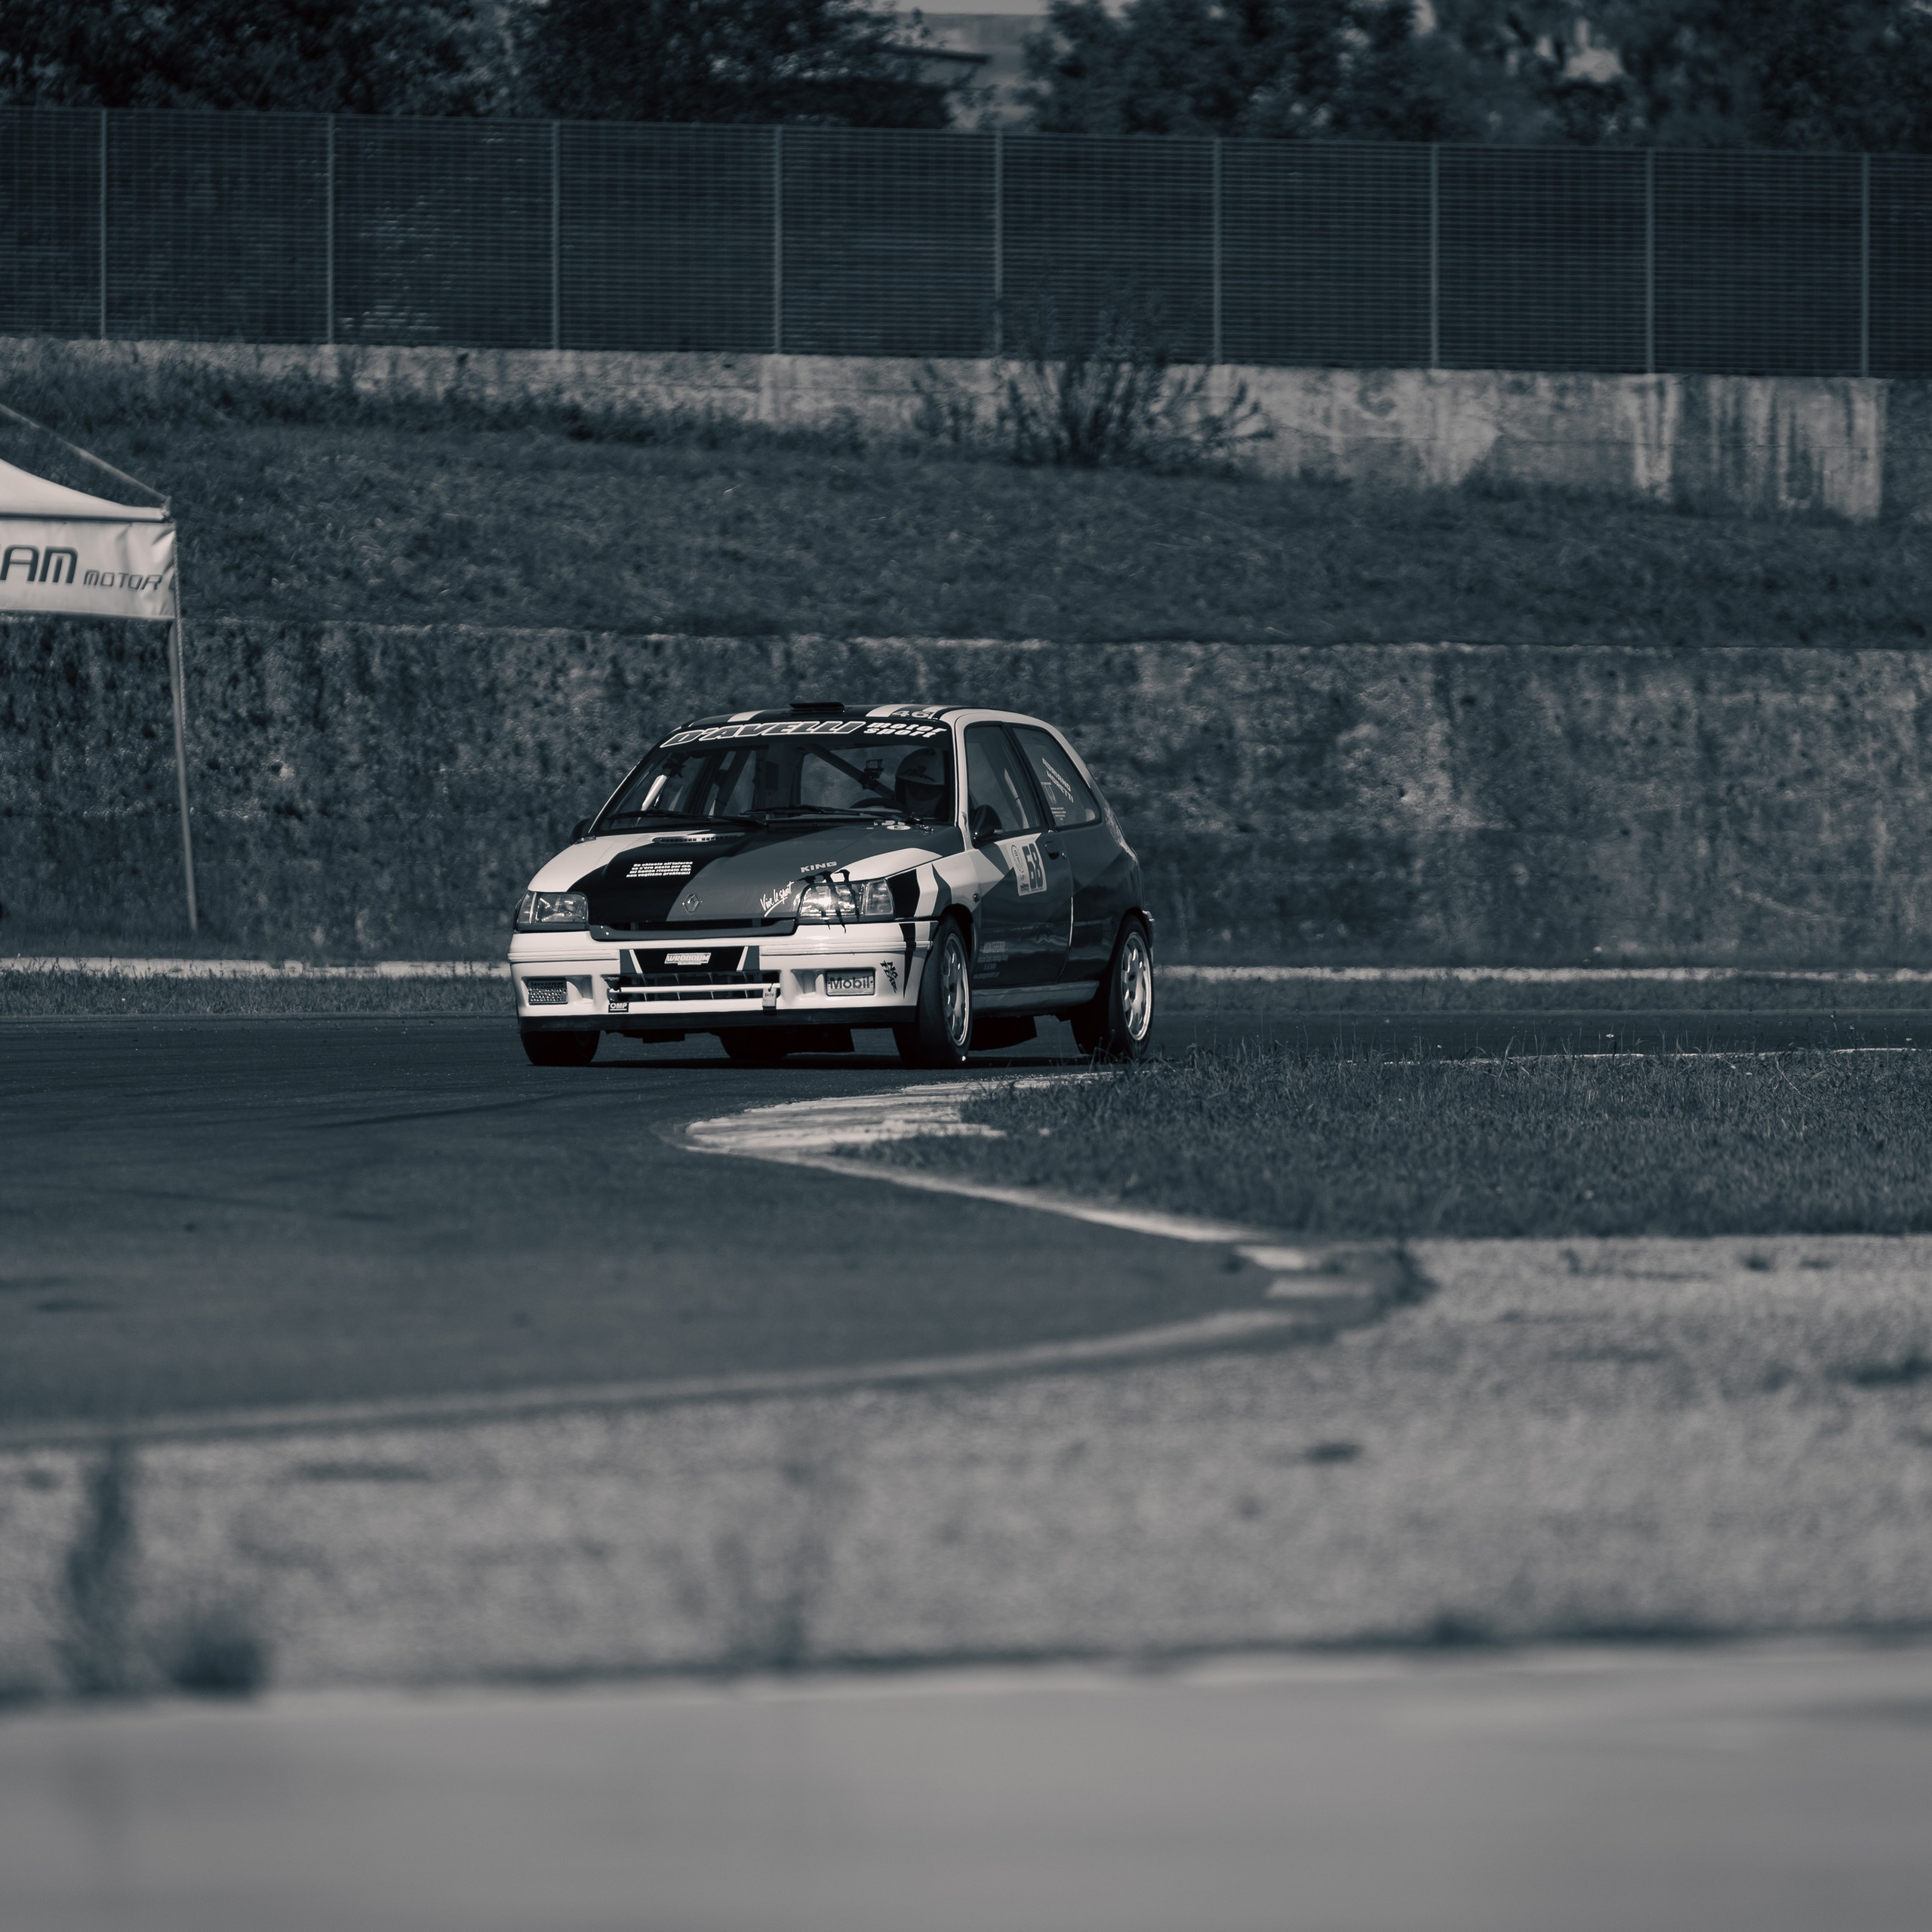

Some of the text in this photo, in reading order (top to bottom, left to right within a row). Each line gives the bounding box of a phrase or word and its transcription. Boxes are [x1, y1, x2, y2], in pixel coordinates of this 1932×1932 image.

[0, 543, 78, 583] AM
[83, 569, 163, 590] MOTOR
[660, 721, 866, 748] D'AVELLI
[863, 728, 940, 738] sport
[866, 722, 947, 733] motor
[1041, 757, 1072, 792] ADRIANO
[1046, 770, 1074, 803] MORETTI
[800, 861, 837, 873] KING
[1021, 843, 1044, 889] 58
[830, 977, 870, 989] Mobil
